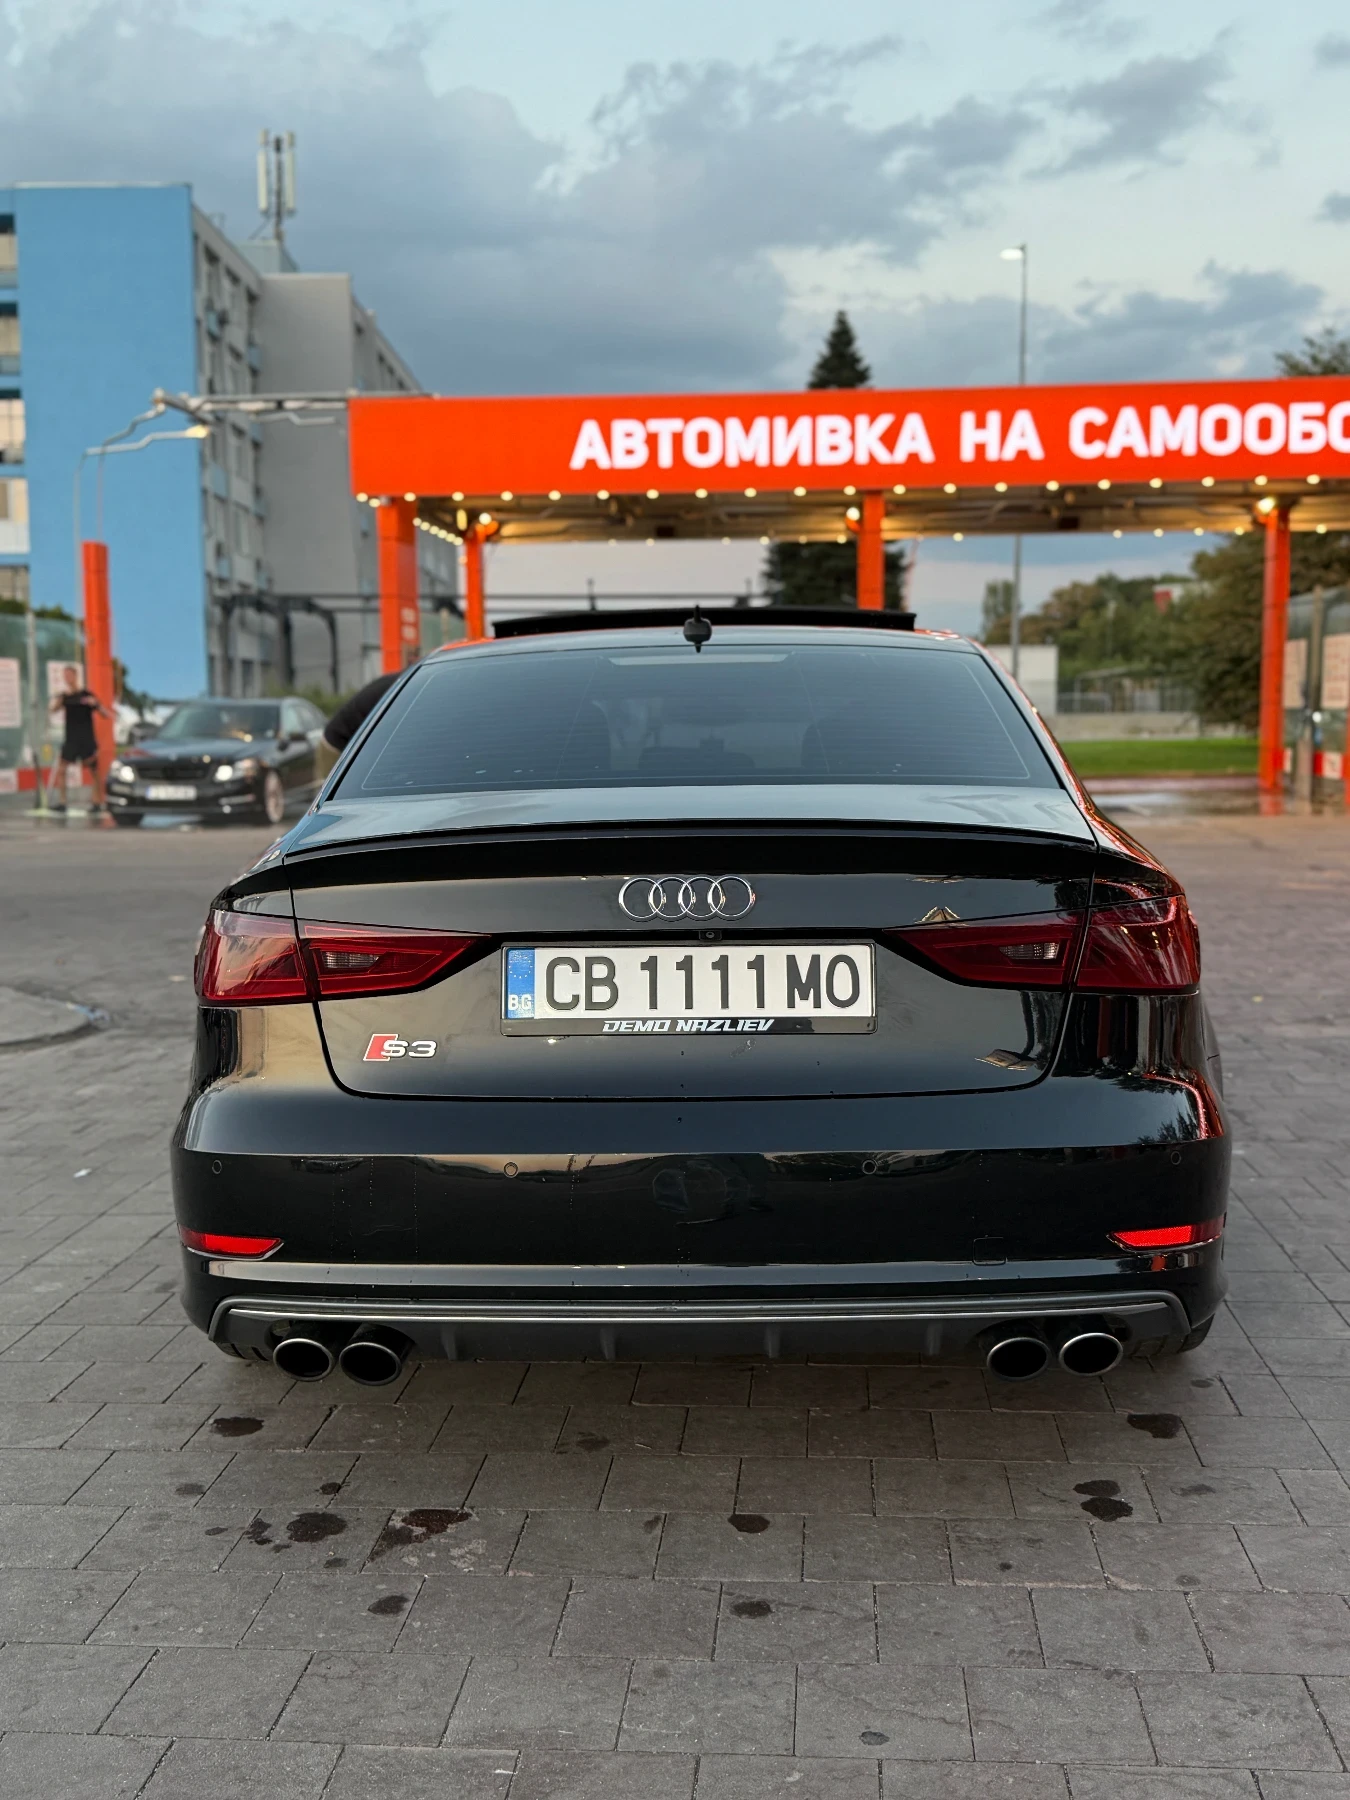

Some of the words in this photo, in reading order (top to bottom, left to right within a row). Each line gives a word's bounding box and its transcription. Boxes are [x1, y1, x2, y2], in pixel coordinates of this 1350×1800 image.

[570, 413, 935, 469] АВТОМИВКА
[960, 409, 1045, 462] НА
[545, 956, 619, 1011] CB
[640, 954, 765, 1010] 1111
[786, 954, 860, 1009] MO
[508, 994, 532, 1010] BG
[602, 1020, 672, 1032] DEMO
[675, 1019, 775, 1031] NAZLIEV
[381, 1040, 437, 1057] S3
